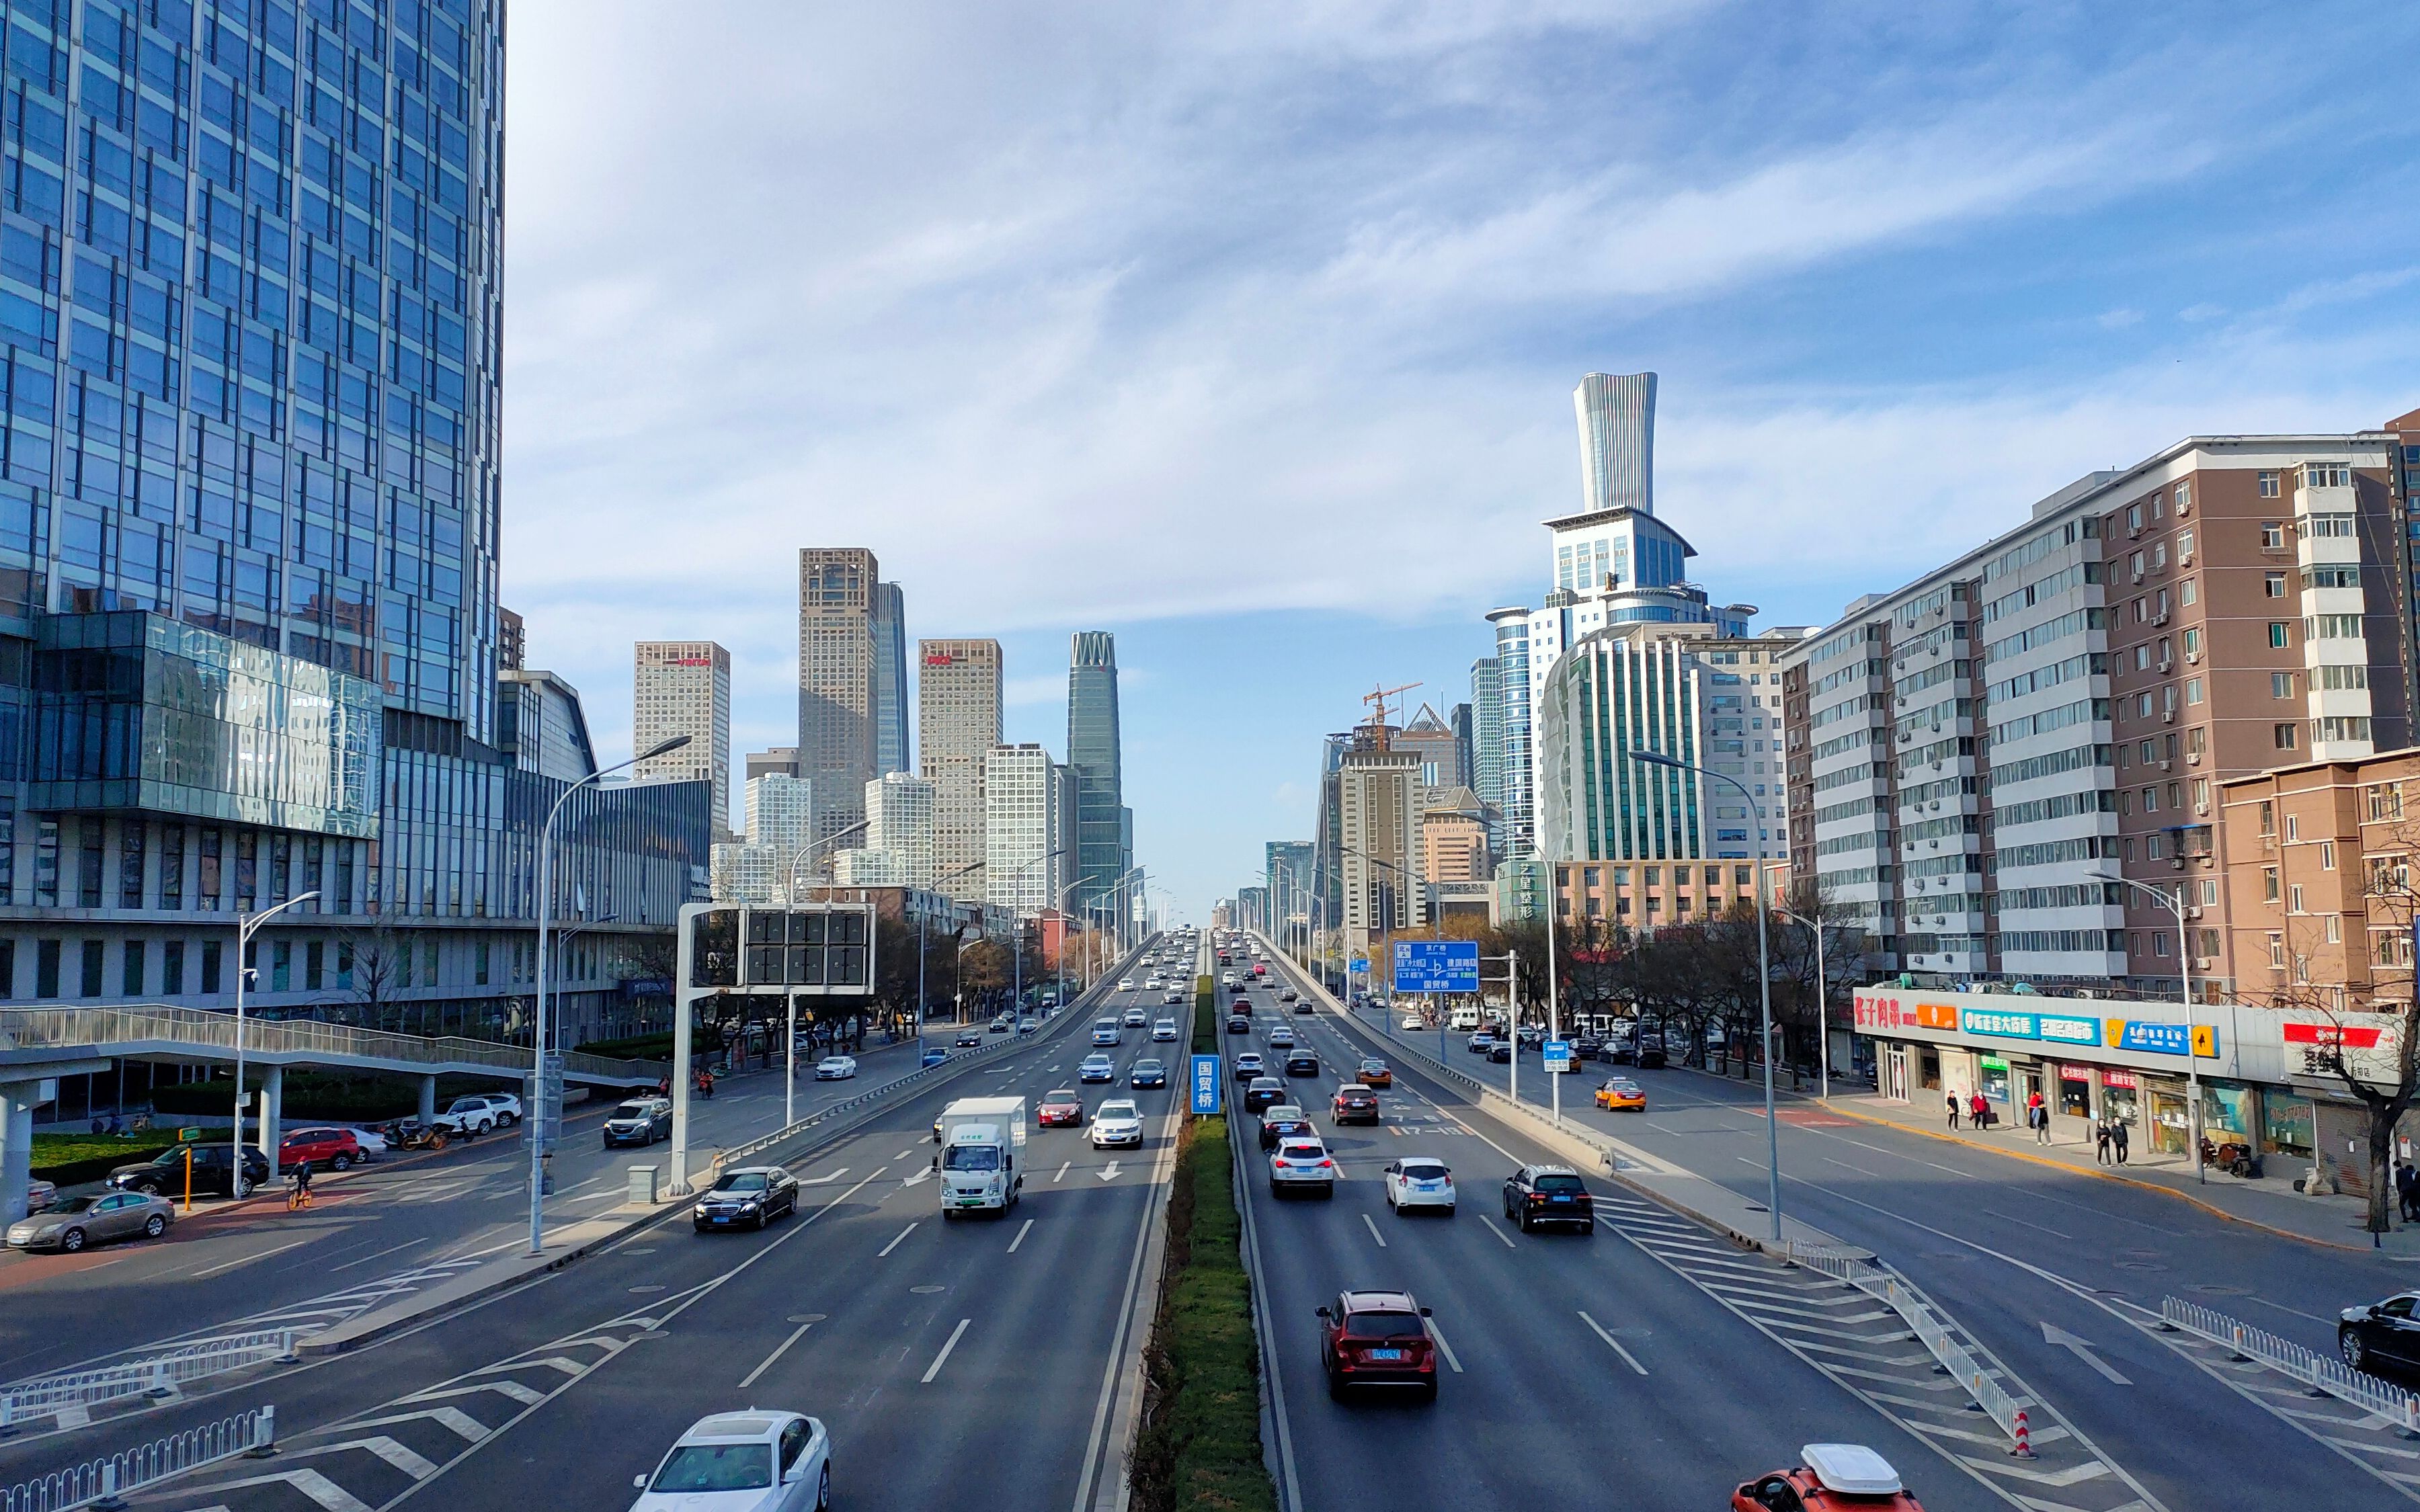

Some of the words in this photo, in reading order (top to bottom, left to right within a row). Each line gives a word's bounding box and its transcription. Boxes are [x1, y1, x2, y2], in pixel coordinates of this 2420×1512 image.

[1519, 864, 1533, 919] 艺星整形
[1424, 980, 1450, 989] 国贸桥
[1198, 1062, 1213, 1108] 国贸桥
